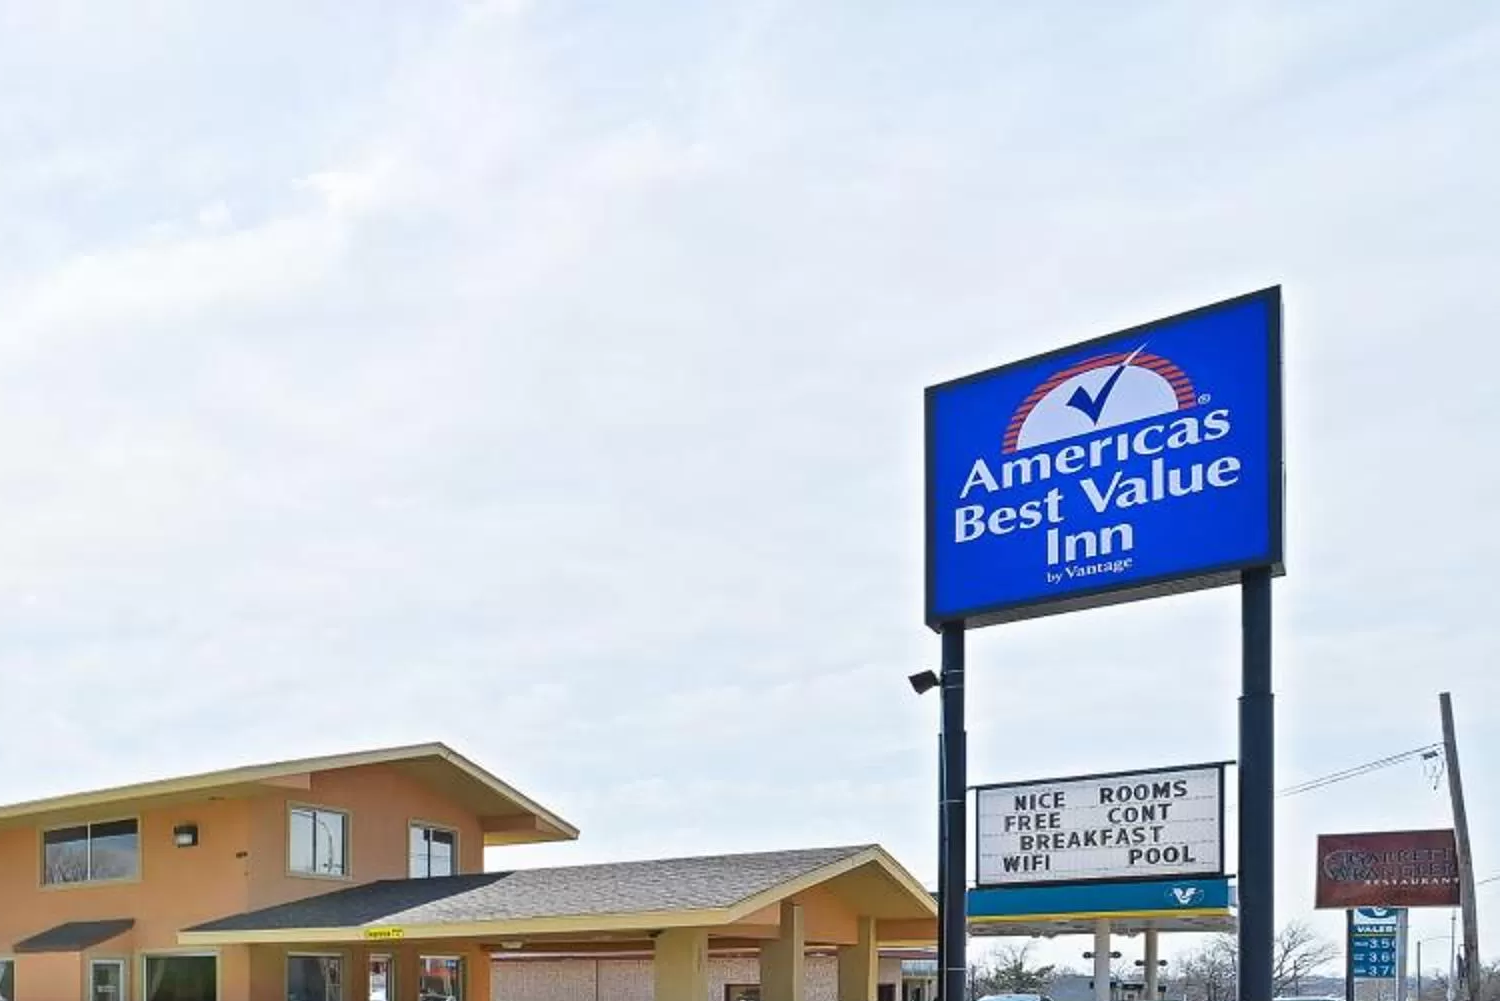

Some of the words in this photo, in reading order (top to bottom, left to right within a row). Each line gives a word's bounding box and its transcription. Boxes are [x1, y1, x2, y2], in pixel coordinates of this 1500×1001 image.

[960, 408, 1231, 499] Americas
[954, 487, 1064, 544] Best
[1080, 455, 1241, 513] Value
[1046, 522, 1134, 566] Inn
[1046, 572, 1063, 585] by
[1065, 557, 1134, 579] Vantage
[1014, 791, 1067, 811] NICE
[1099, 780, 1188, 805] ROOMS
[1004, 811, 1061, 832] FREE
[1108, 803, 1172, 825] CONT
[1020, 826, 1165, 851] BREAKFAST
[1003, 854, 1050, 873] WIFI
[1128, 845, 1196, 866] POOL
[1357, 925, 1397, 933] VALER
